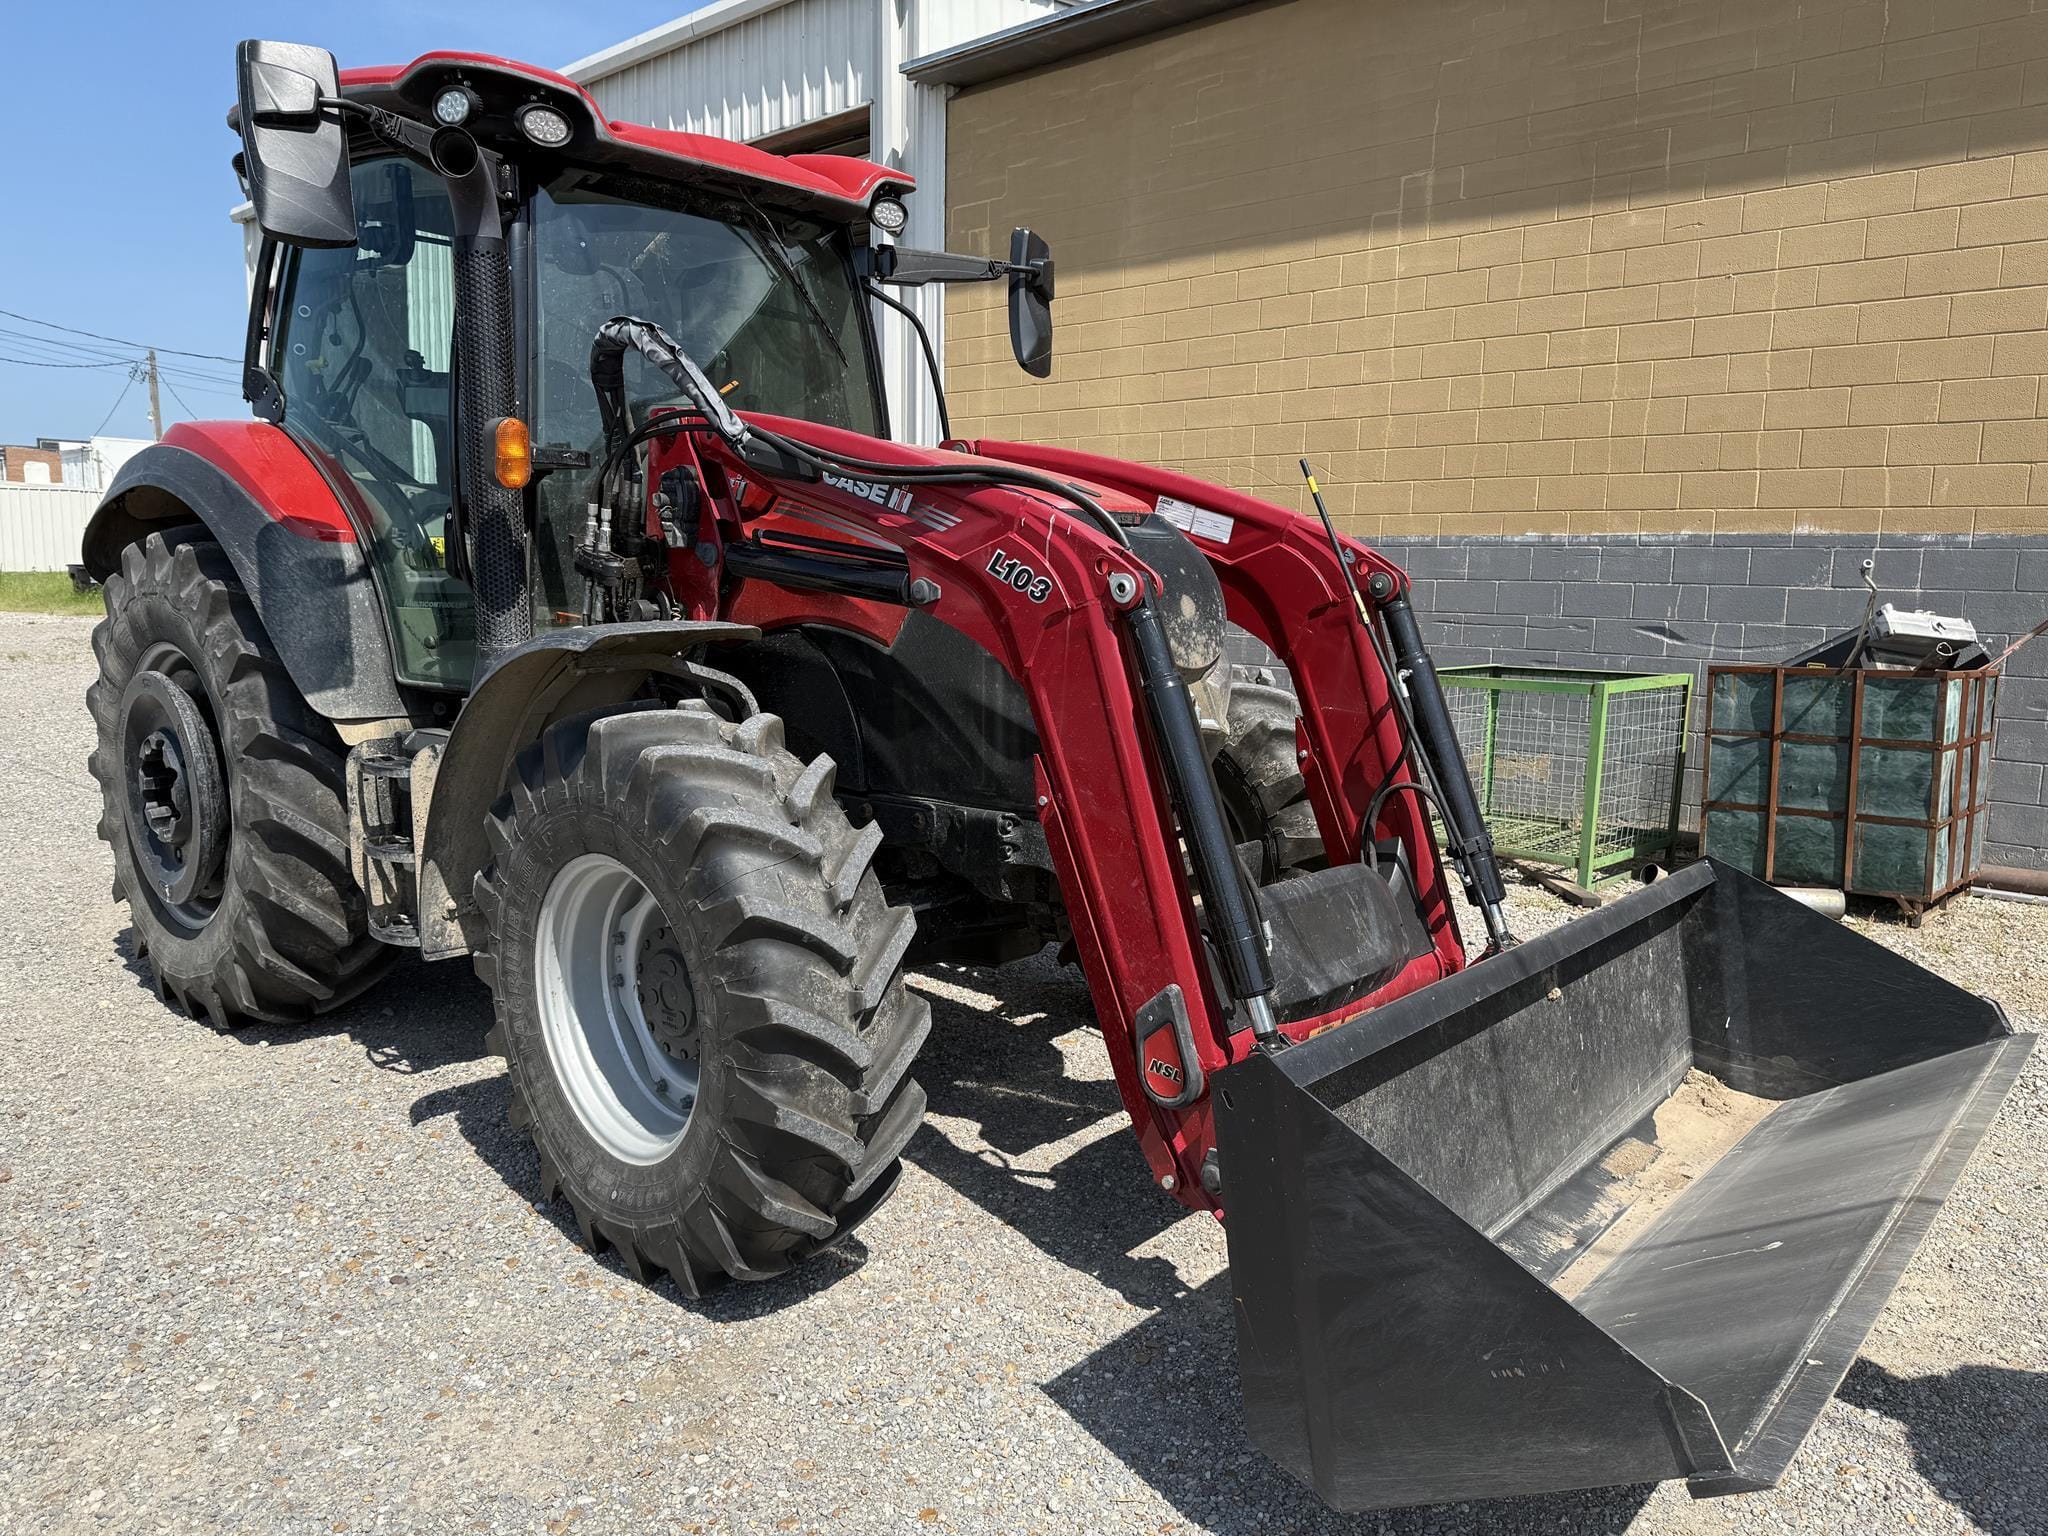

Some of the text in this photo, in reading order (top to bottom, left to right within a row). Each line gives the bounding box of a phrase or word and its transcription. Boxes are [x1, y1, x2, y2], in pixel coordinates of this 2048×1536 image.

[822, 471, 890, 506] CASE
[985, 548, 1053, 604] L103
[1147, 1058, 1181, 1085] NSL
